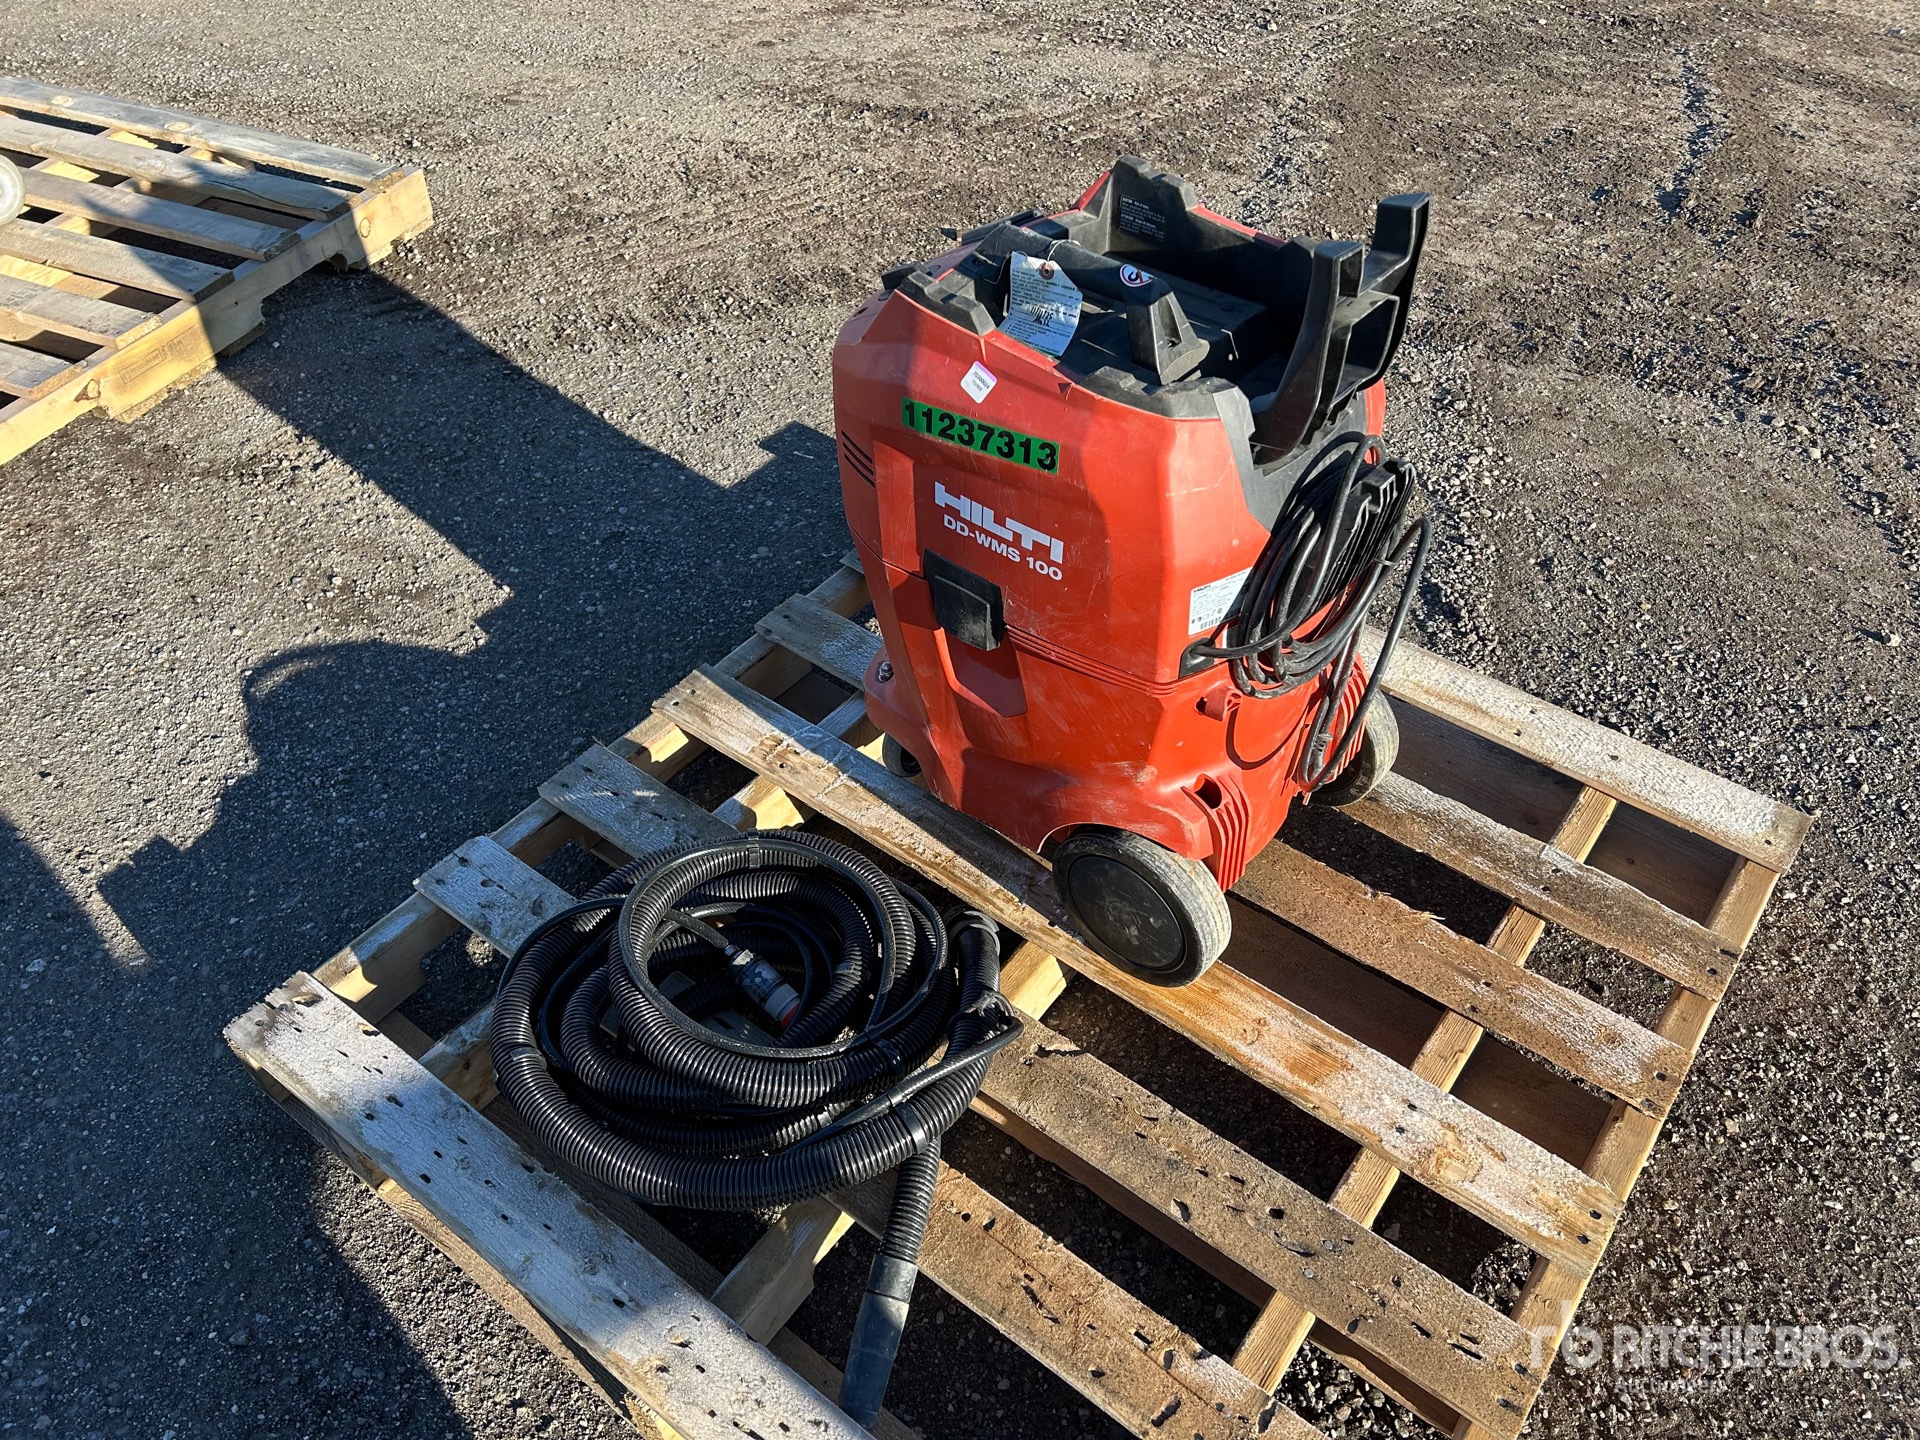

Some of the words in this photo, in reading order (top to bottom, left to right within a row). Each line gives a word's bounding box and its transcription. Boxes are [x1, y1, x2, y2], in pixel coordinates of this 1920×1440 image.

[904, 402, 1057, 471] 11237313
[934, 481, 1064, 564] HILTI
[943, 513, 1021, 563] DD-WMS
[1026, 556, 1063, 581] 100
